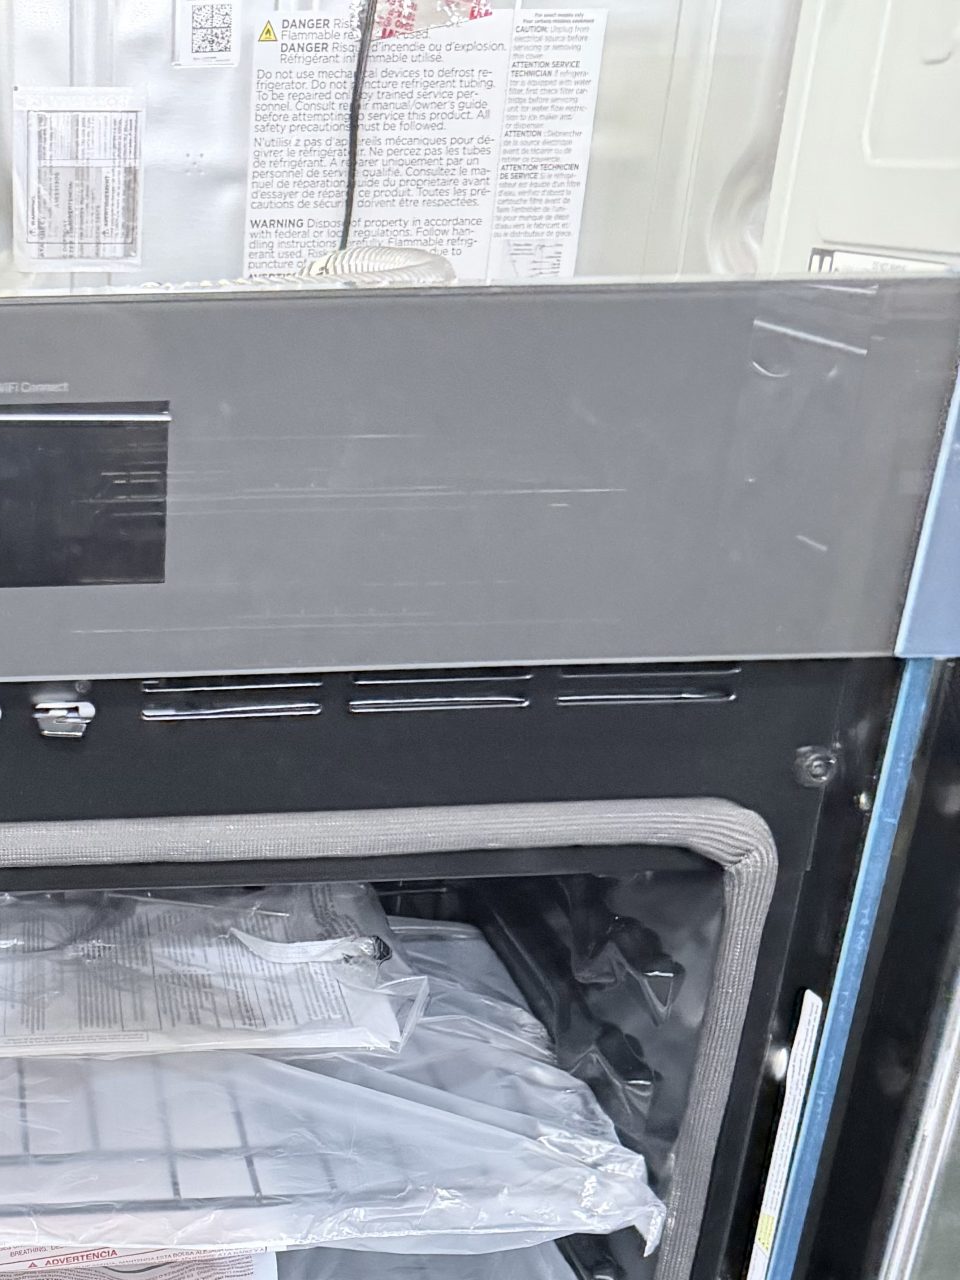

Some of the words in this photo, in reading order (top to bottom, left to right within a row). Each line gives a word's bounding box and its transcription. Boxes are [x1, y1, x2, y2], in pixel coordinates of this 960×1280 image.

[281, 19, 330, 29] DANGER
[281, 30, 340, 40] Flammable
[280, 43, 329, 52] DANGER
[371, 41, 425, 52] d'incendie
[428, 43, 442, 52] ou
[445, 41, 506, 55] d'explosion.
[551, 60, 581, 68] SERVICE
[256, 69, 272, 79] Do
[275, 70, 292, 79] not
[296, 71, 315, 79] use
[380, 68, 420, 78] devices
[423, 69, 434, 78] to
[438, 67, 475, 78] defrost
[478, 68, 493, 77] re-
[256, 79, 306, 91] frigerator.
[311, 80, 326, 90] Do
[329, 80, 347, 90] not
[401, 79, 457, 90] refrigerant
[459, 78, 495, 90] tubing.
[256, 91, 269, 101] To
[271, 90, 284, 101] be
[288, 90, 331, 102] repaired
[377, 90, 413, 100] trained
[417, 90, 453, 99] service
[456, 90, 478, 101] per-
[255, 101, 292, 111] sonnel.
[295, 101, 335, 111] Consult
[458, 99, 488, 111] guide
[254, 112, 289, 122] before
[293, 112, 351, 124] attempting
[367, 111, 405, 121] service
[408, 110, 426, 120] this
[429, 111, 474, 122] product.
[476, 109, 490, 120] All
[254, 122, 286, 134] safety
[289, 123, 351, 134] precautions
[382, 121, 396, 131] be
[399, 121, 446, 131] followed.
[303, 139, 322, 149] pas
[450, 137, 474, 147] pour
[253, 148, 283, 160] givrer
[287, 147, 296, 157] le
[369, 147, 384, 157] Ne
[386, 148, 421, 158] percez
[424, 148, 442, 157] pas
[445, 146, 459, 156] les
[462, 146, 491, 156] tubes
[253, 158, 266, 168] de
[382, 157, 444, 168] uniquement
[446, 157, 463, 168] par
[466, 157, 479, 166] un
[252, 168, 303, 180] personnel
[306, 168, 320, 178] de
[405, 166, 456, 176] Consultez
[459, 166, 468, 176] le
[471, 167, 491, 176] ma-
[251, 179, 274, 189] nuel
[276, 179, 290, 189] de
[382, 177, 395, 187] du
[462, 177, 490, 186] avant
[251, 190, 299, 201] d'essayer
[302, 189, 315, 199] de
[358, 190, 371, 198] ce
[373, 188, 414, 199] produit.
[417, 187, 450, 197] Toutes
[453, 186, 467, 197] les
[250, 200, 294, 210] cautions
[297, 199, 311, 209] de
[357, 198, 396, 208] doivent
[250, 218, 304, 229] WARNING
[351, 217, 362, 227] of
[364, 218, 409, 229] property
[412, 217, 420, 226] in
[423, 216, 483, 227] accordance
[250, 229, 272, 239] with
[274, 228, 310, 239] federal
[313, 230, 324, 239] or
[354, 228, 413, 239] regulations.
[416, 227, 450, 237] Follow
[452, 226, 475, 236] han-
[248, 240, 274, 251] dling
[278, 239, 337, 249] instructions
[387, 237, 444, 247] Flammable
[446, 236, 478, 248] refrig-
[248, 250, 275, 259] erant
[278, 249, 304, 259] used.
[452, 246, 462, 256] to
[248, 259, 294, 271] puncture
[21, 382, 69, 393] Connect
[44, 1249, 118, 1266] ADVERTENCIA
